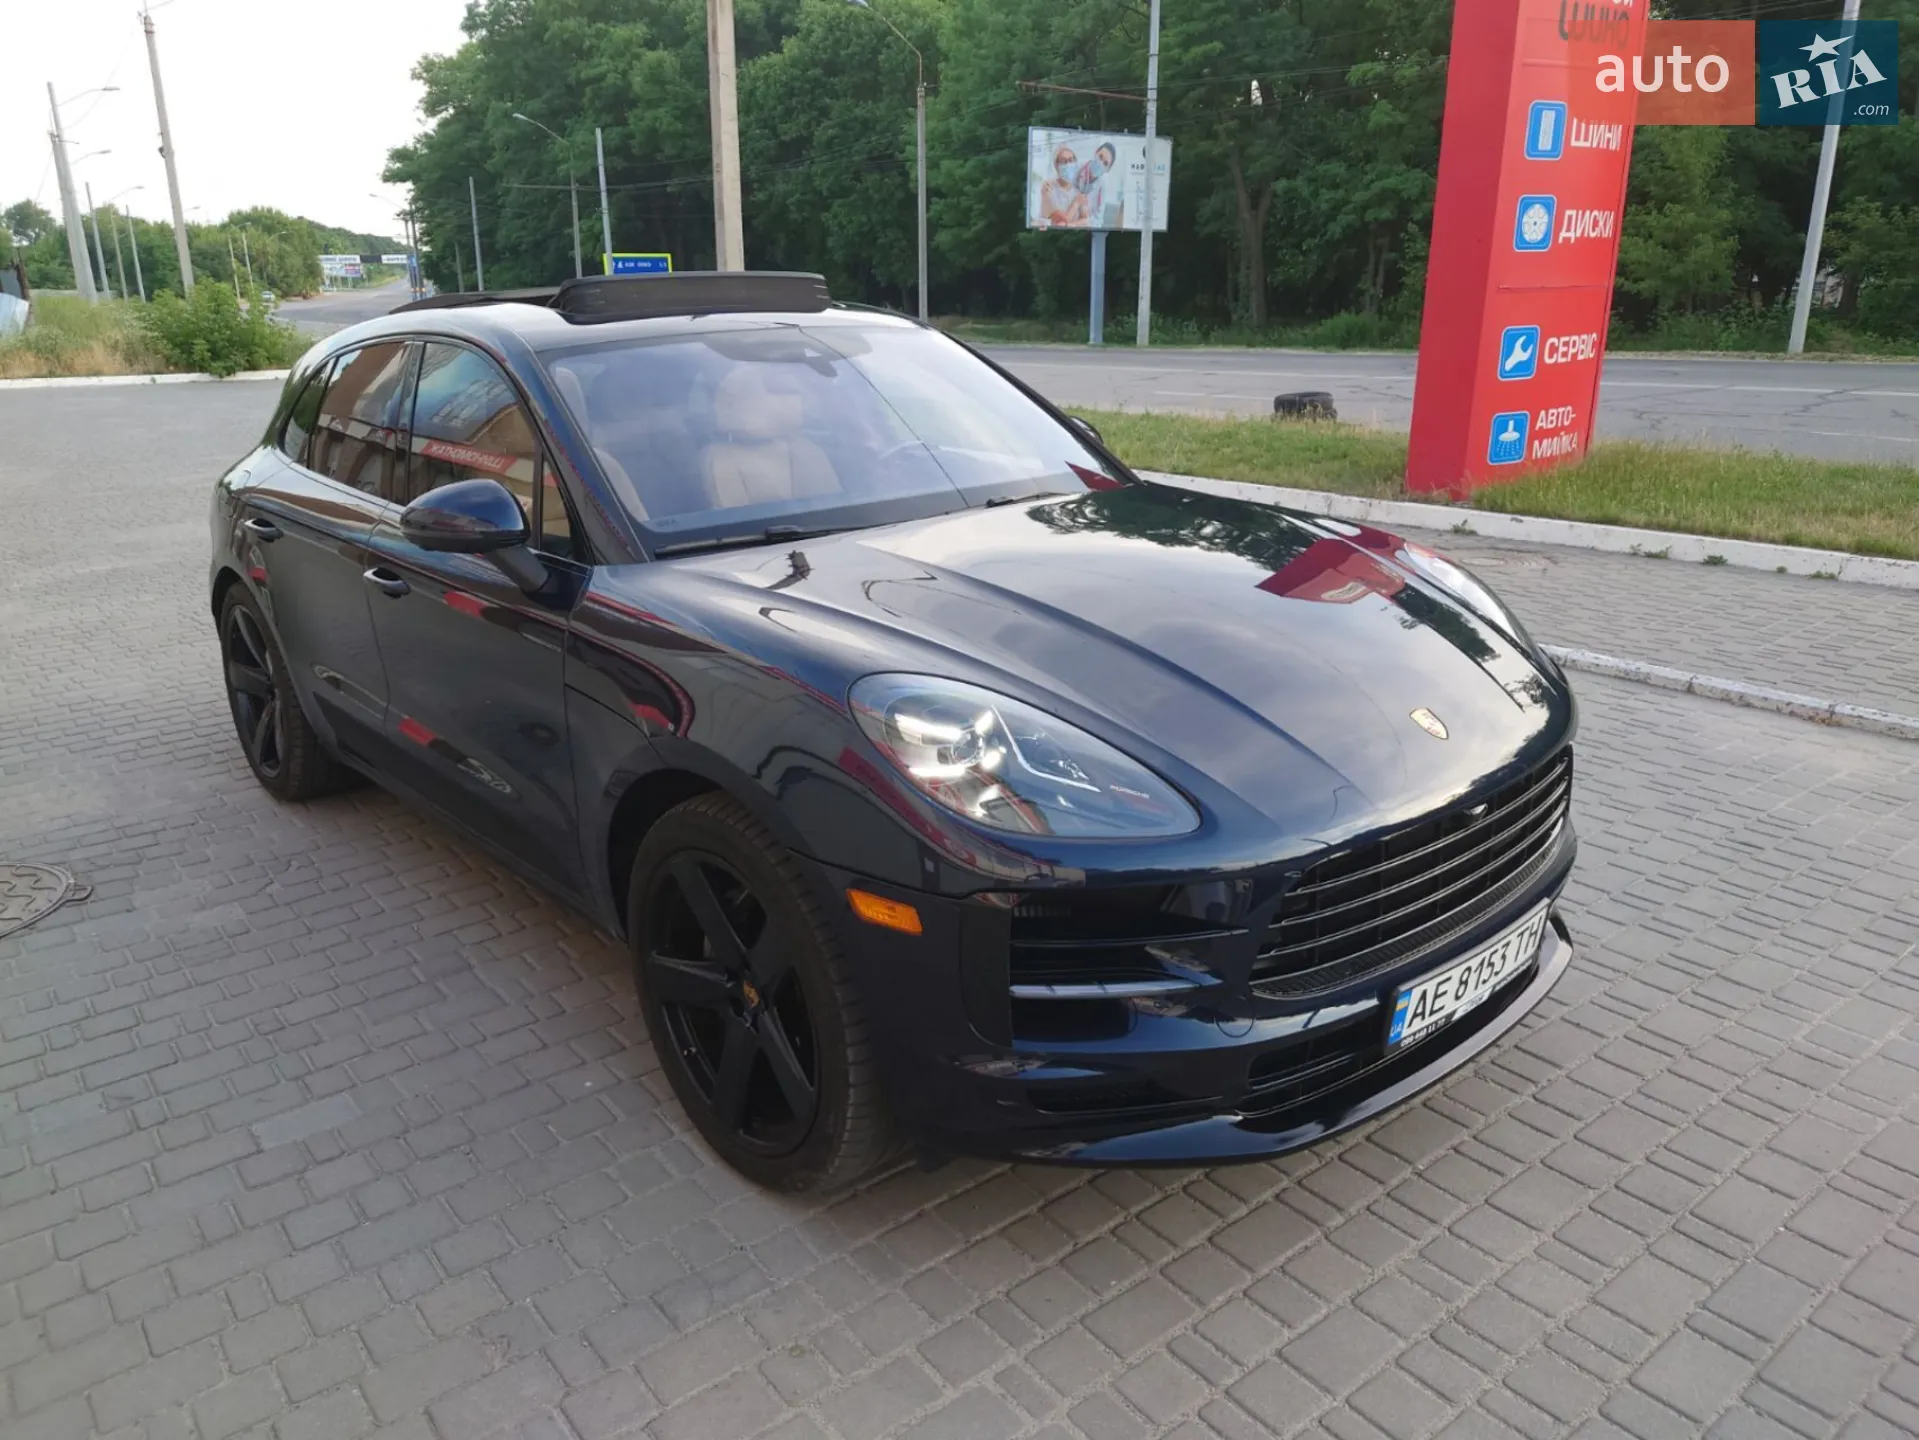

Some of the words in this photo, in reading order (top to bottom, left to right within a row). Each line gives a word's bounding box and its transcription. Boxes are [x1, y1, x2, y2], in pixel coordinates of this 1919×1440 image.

[1570, 117, 1623, 151] ШИНИ
[1558, 209, 1615, 244] ДИСКИ
[1543, 332, 1598, 364] СЕРВІС
[1535, 405, 1577, 431] АВТО-
[1531, 431, 1579, 460] МИЙКА
[1407, 975, 1453, 1028] AE
[1454, 941, 1513, 1001] 8153
[1514, 915, 1544, 962] TH
